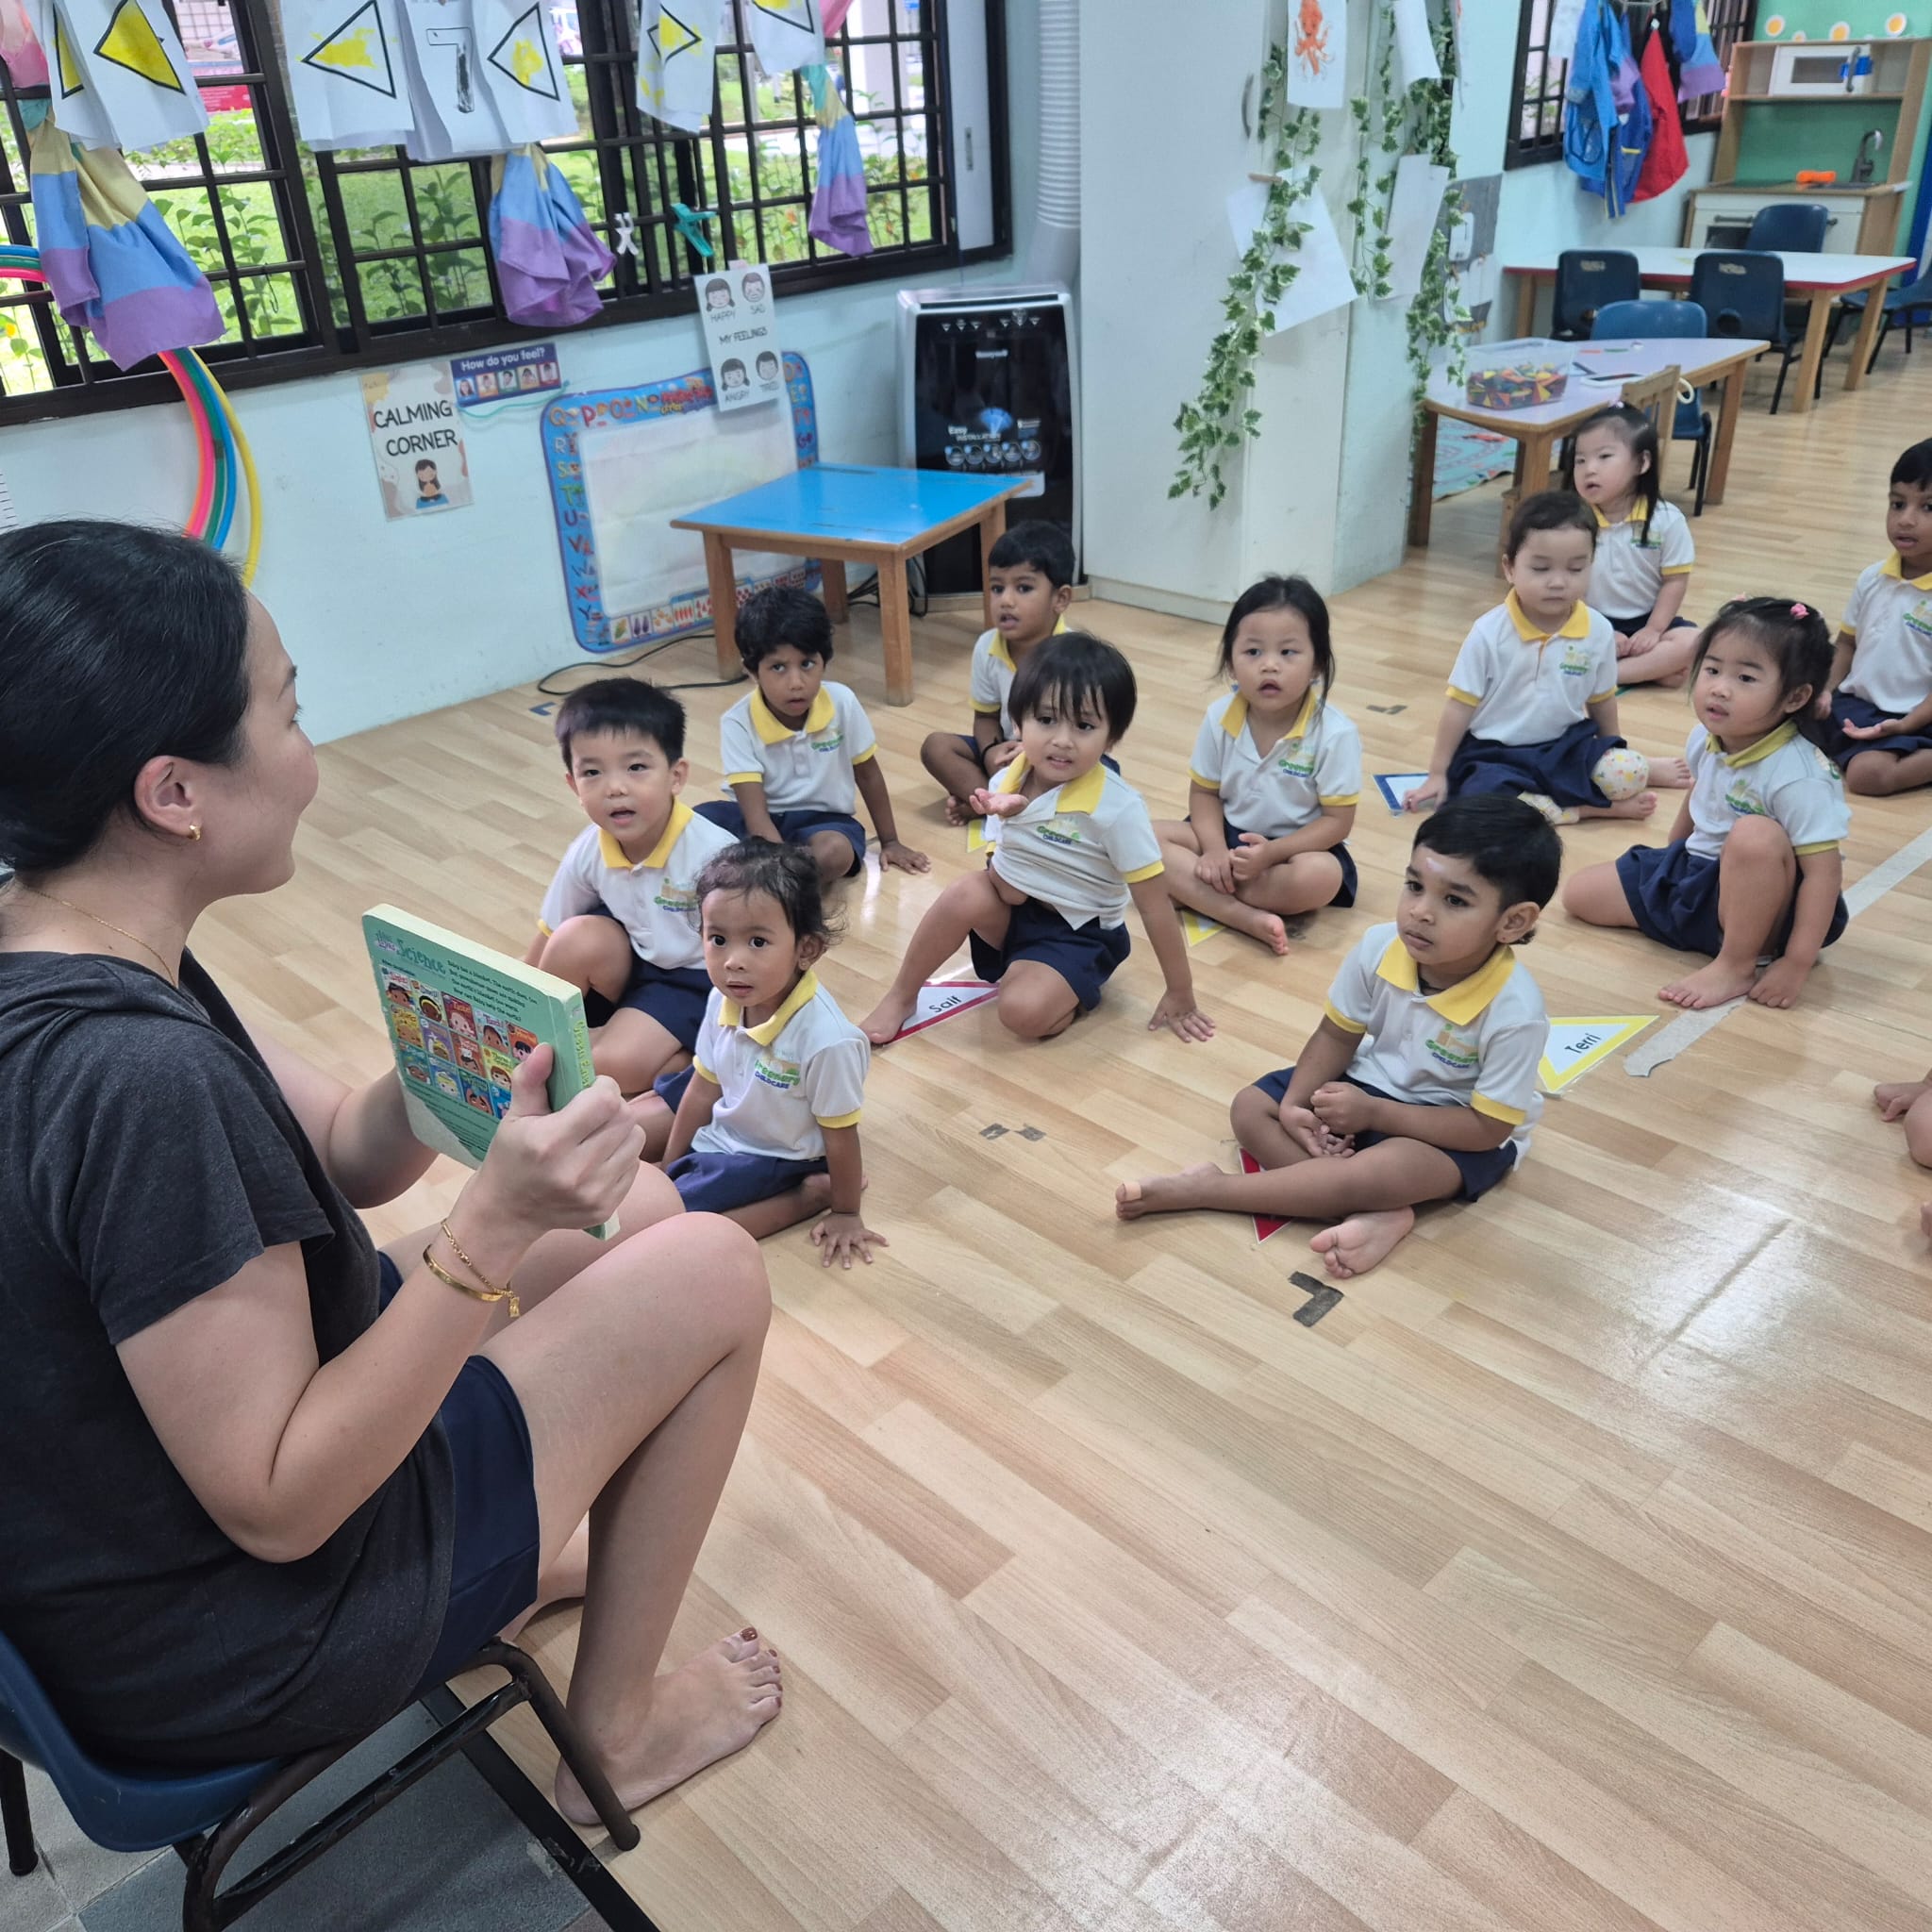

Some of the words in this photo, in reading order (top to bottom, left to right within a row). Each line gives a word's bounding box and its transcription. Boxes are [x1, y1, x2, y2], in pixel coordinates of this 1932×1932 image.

[710, 310, 736, 322] HAPPY
[719, 334, 731, 344] MY
[734, 326, 768, 341] FEELINGS
[461, 359, 484, 371] How
[487, 356, 500, 367] do
[501, 354, 519, 366] you
[521, 347, 545, 359] feel?
[724, 391, 749, 402] ANGRY
[374, 400, 453, 428] CALMING
[386, 429, 458, 457] CORNER
[1564, 1033, 1601, 1054] Terri
[755, 1071, 791, 1089] CHILDCARE
